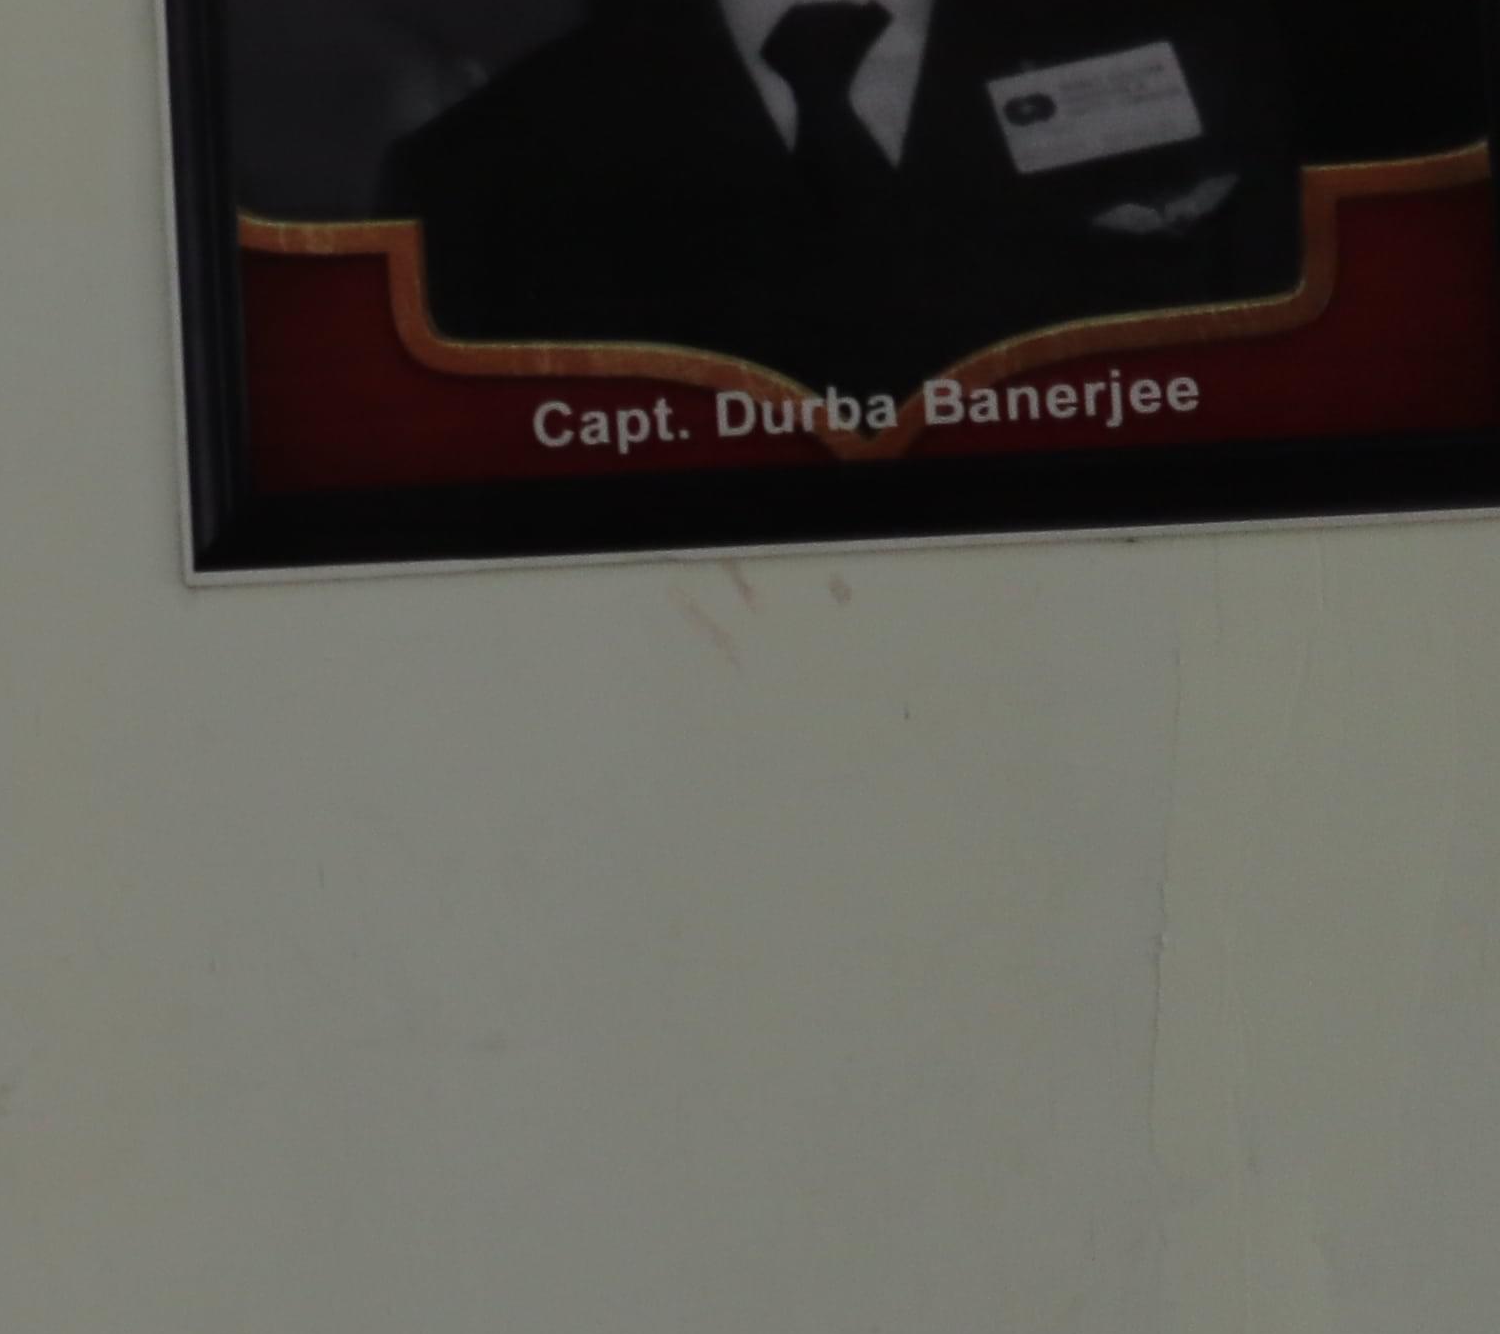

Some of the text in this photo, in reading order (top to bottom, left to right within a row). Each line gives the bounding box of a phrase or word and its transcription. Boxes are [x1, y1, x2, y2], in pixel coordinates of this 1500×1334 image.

[532, 369, 1201, 454] Capt. Durba Banerjee
